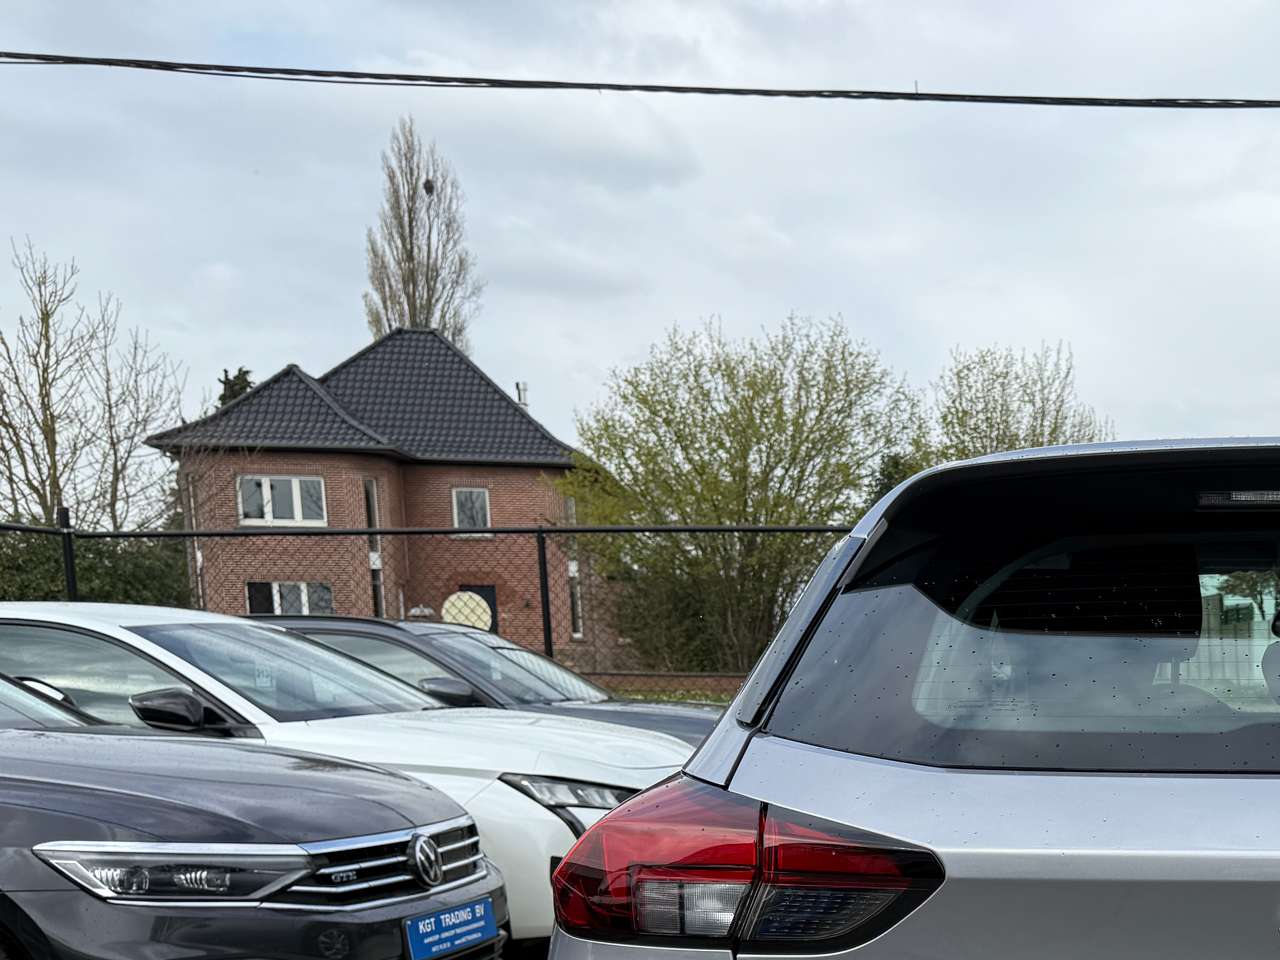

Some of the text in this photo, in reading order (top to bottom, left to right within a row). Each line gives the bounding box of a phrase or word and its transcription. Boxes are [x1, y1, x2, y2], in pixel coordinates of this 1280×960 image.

[418, 918, 436, 934] KGT
[440, 907, 472, 927] TRADING
[475, 903, 485, 917] BV
